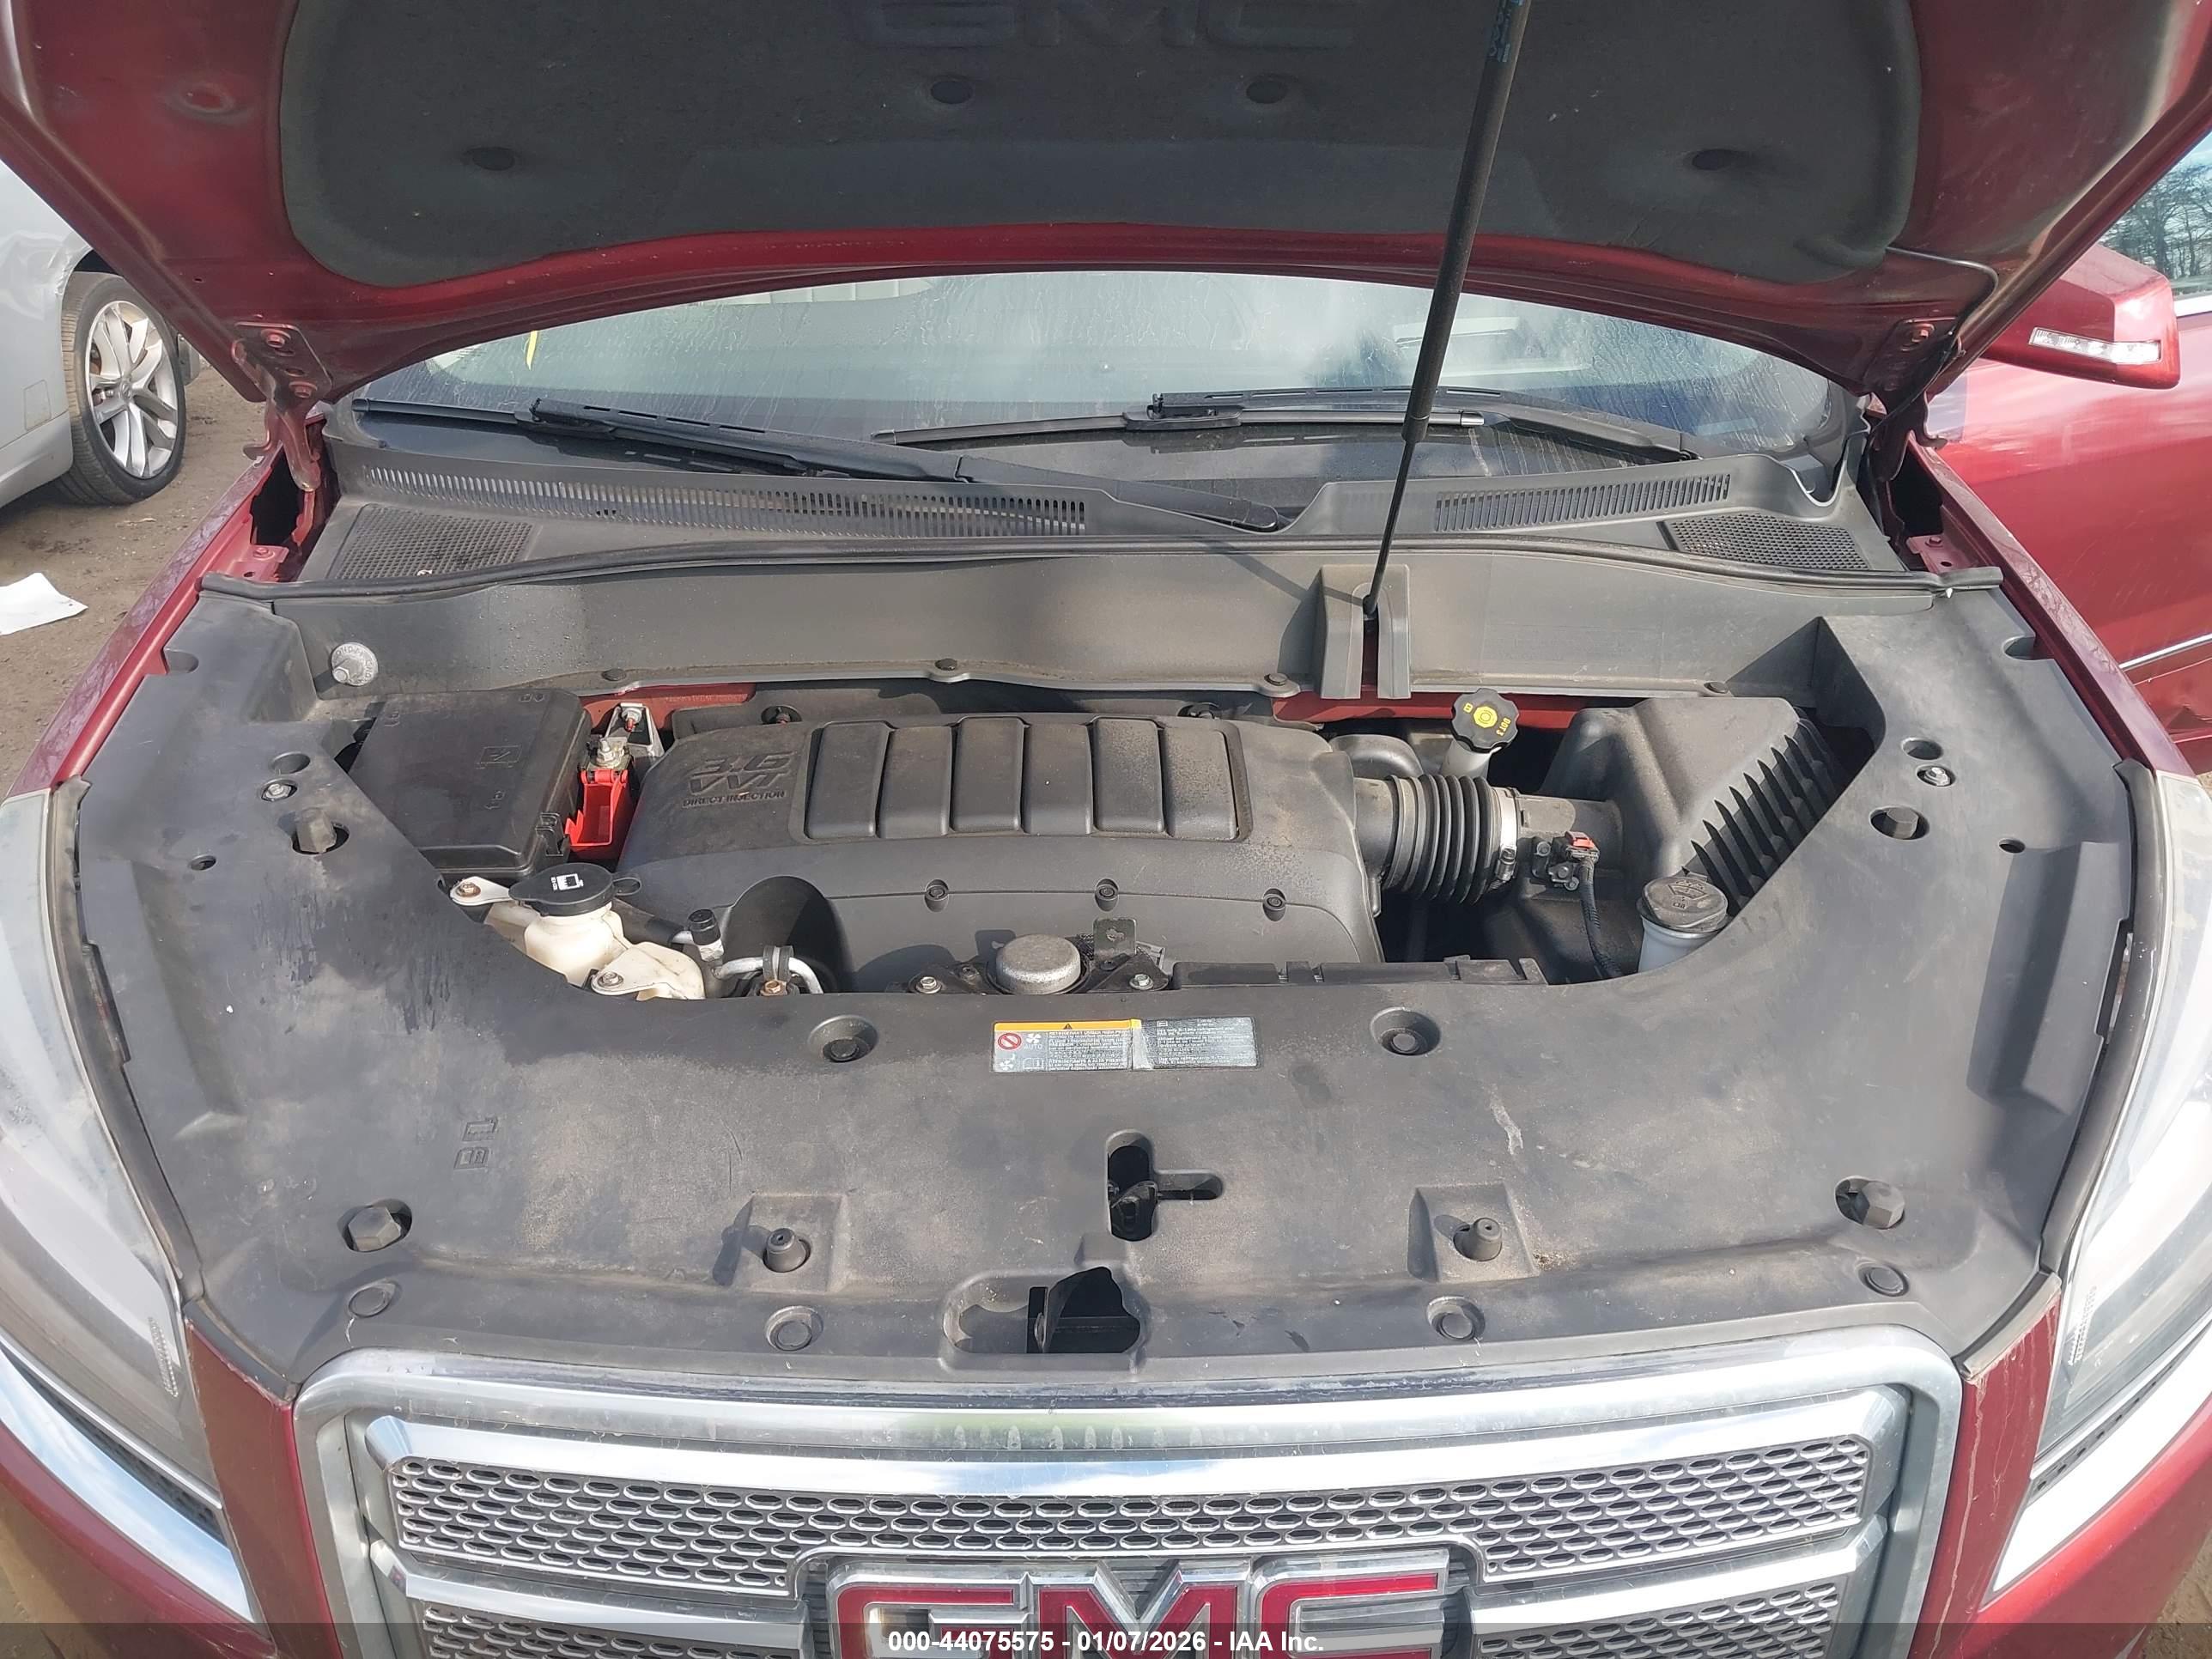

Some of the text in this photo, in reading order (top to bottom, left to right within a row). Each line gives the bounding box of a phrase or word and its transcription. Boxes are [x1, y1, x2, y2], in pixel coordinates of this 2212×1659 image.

[683, 790, 786, 807] DIRECT INJECTION
[828, 1549, 1449, 1659] GMC
